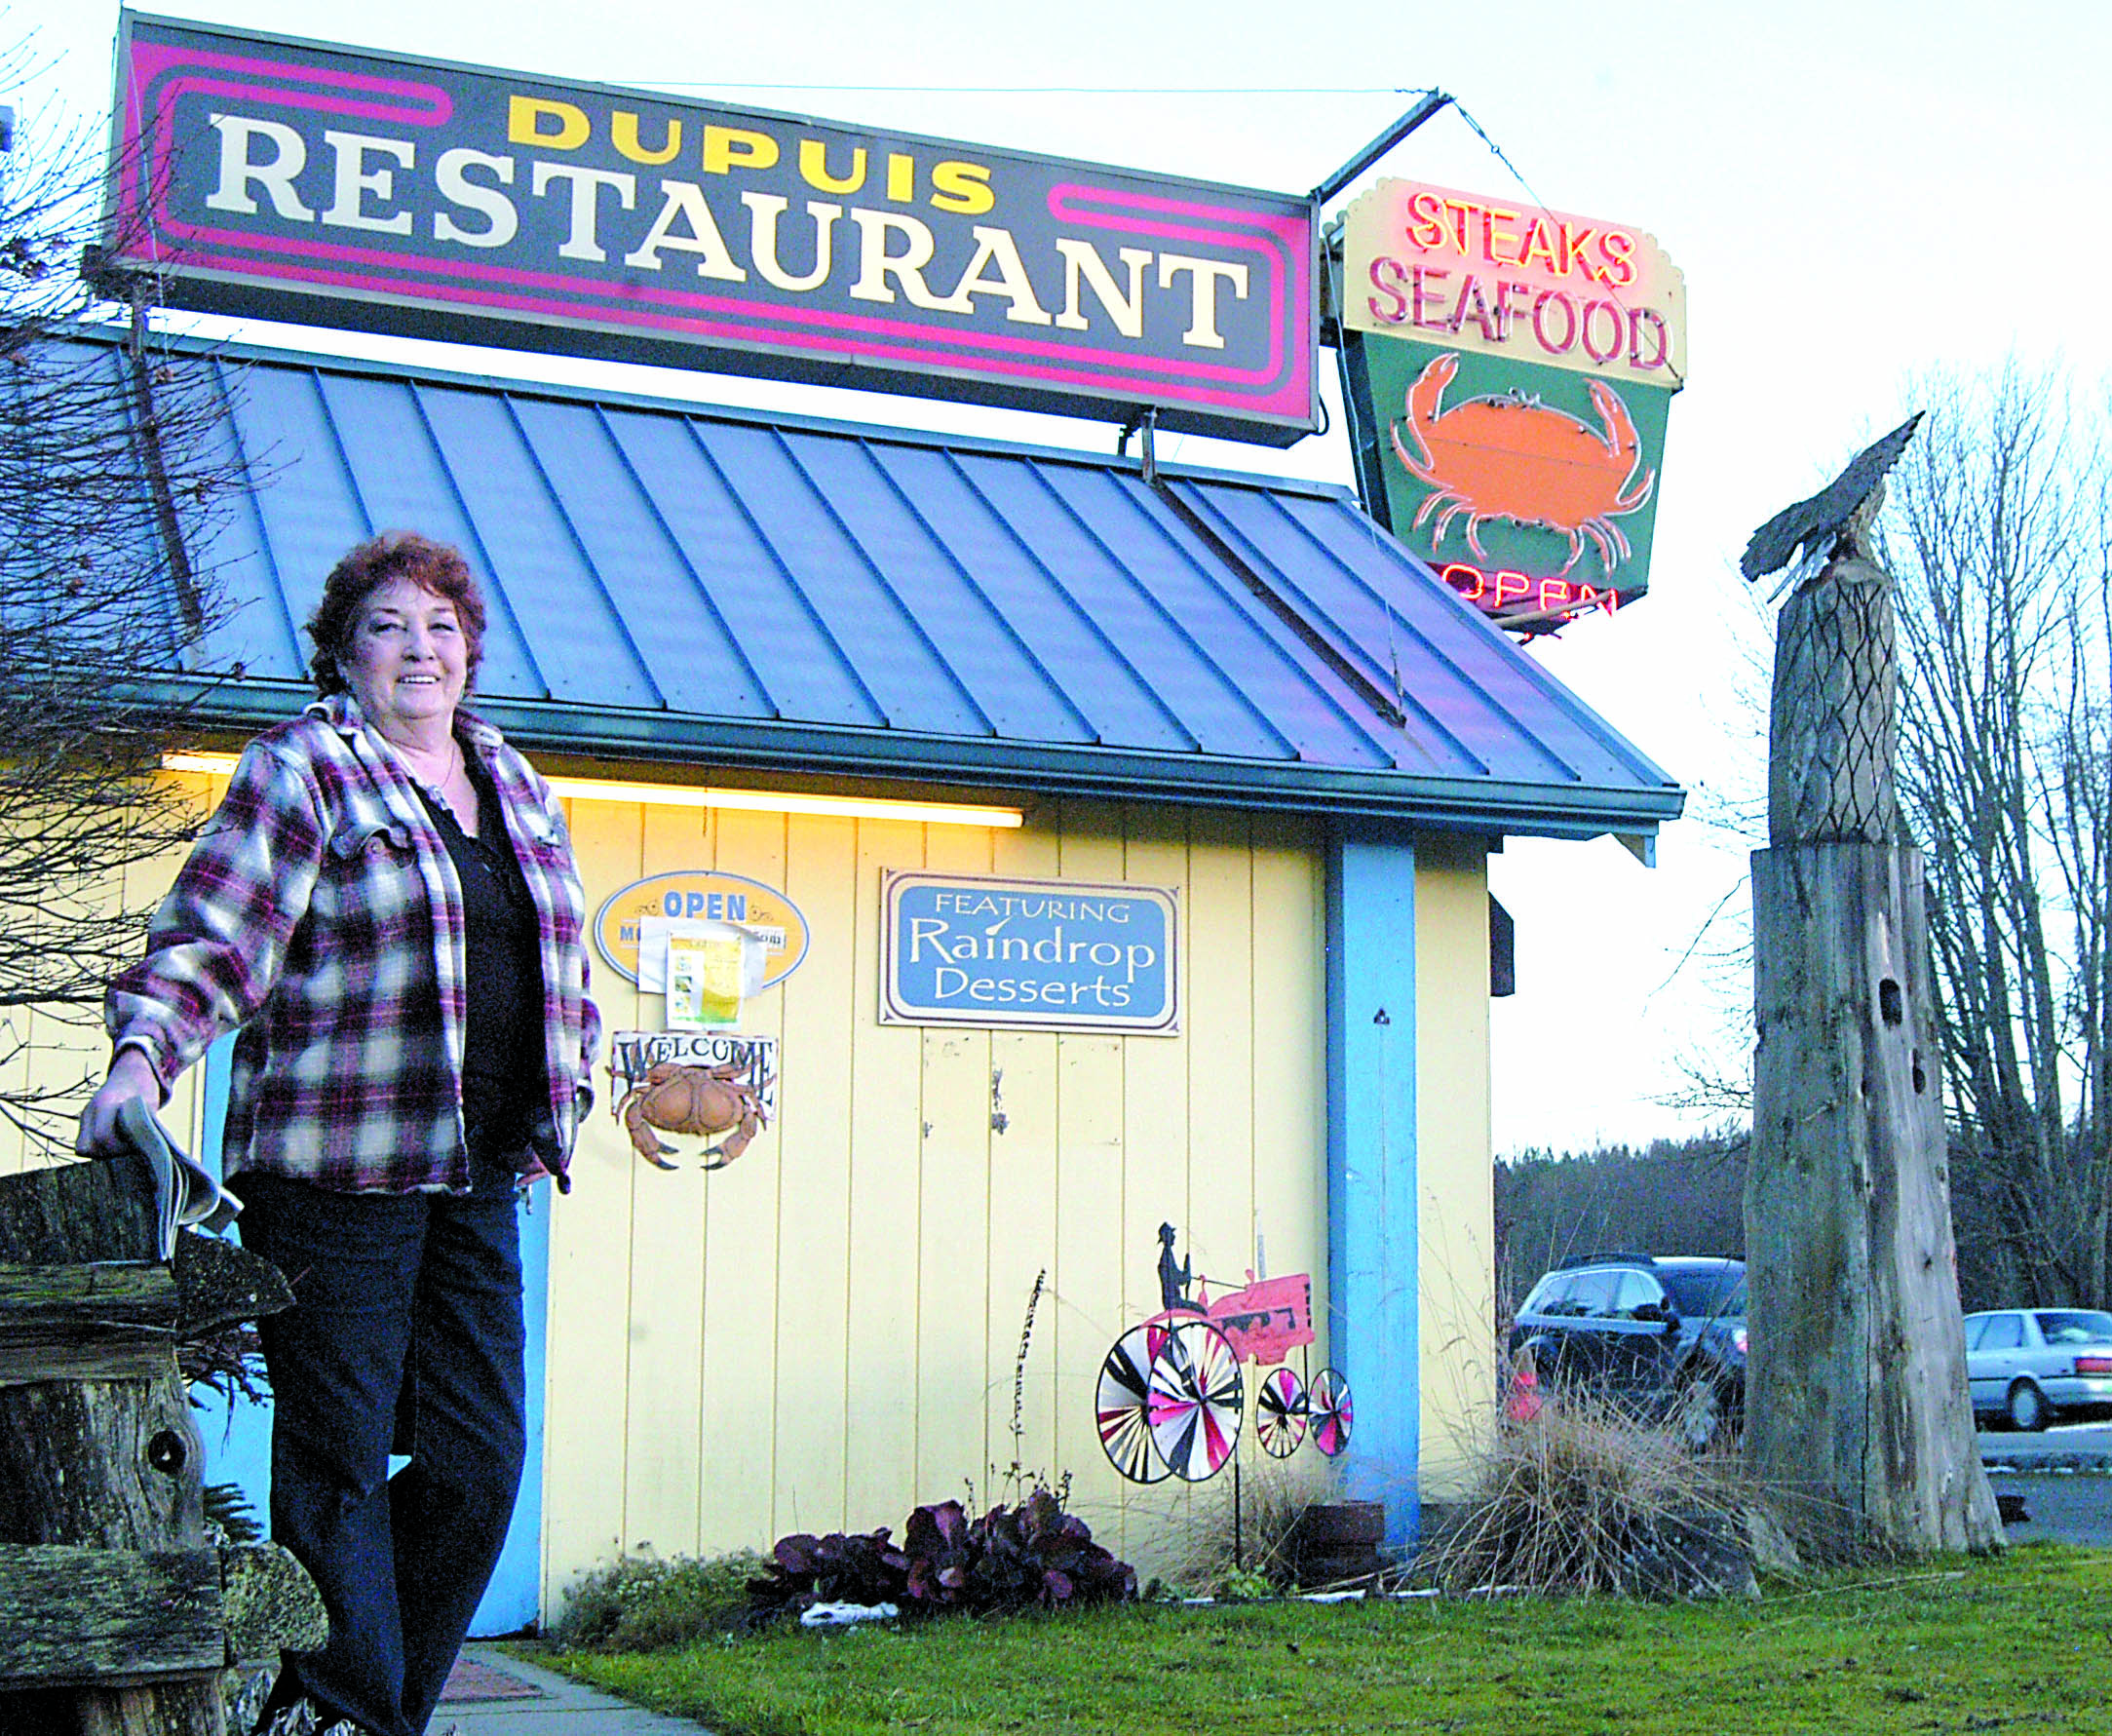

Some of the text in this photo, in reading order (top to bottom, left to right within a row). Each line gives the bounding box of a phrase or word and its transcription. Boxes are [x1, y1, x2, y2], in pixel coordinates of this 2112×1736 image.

[508, 95, 994, 216] DUPUIS
[206, 112, 1248, 350] RESTAURANT
[1405, 191, 1639, 288] STEAKS
[1366, 255, 1675, 370] SEAFOOD
[663, 890, 748, 921] OPEN
[935, 893, 1131, 924] FEATURING
[909, 916, 1155, 984] Raindrop
[934, 966, 1132, 1007] Desserts
[617, 1035, 776, 1107] WELCOME
